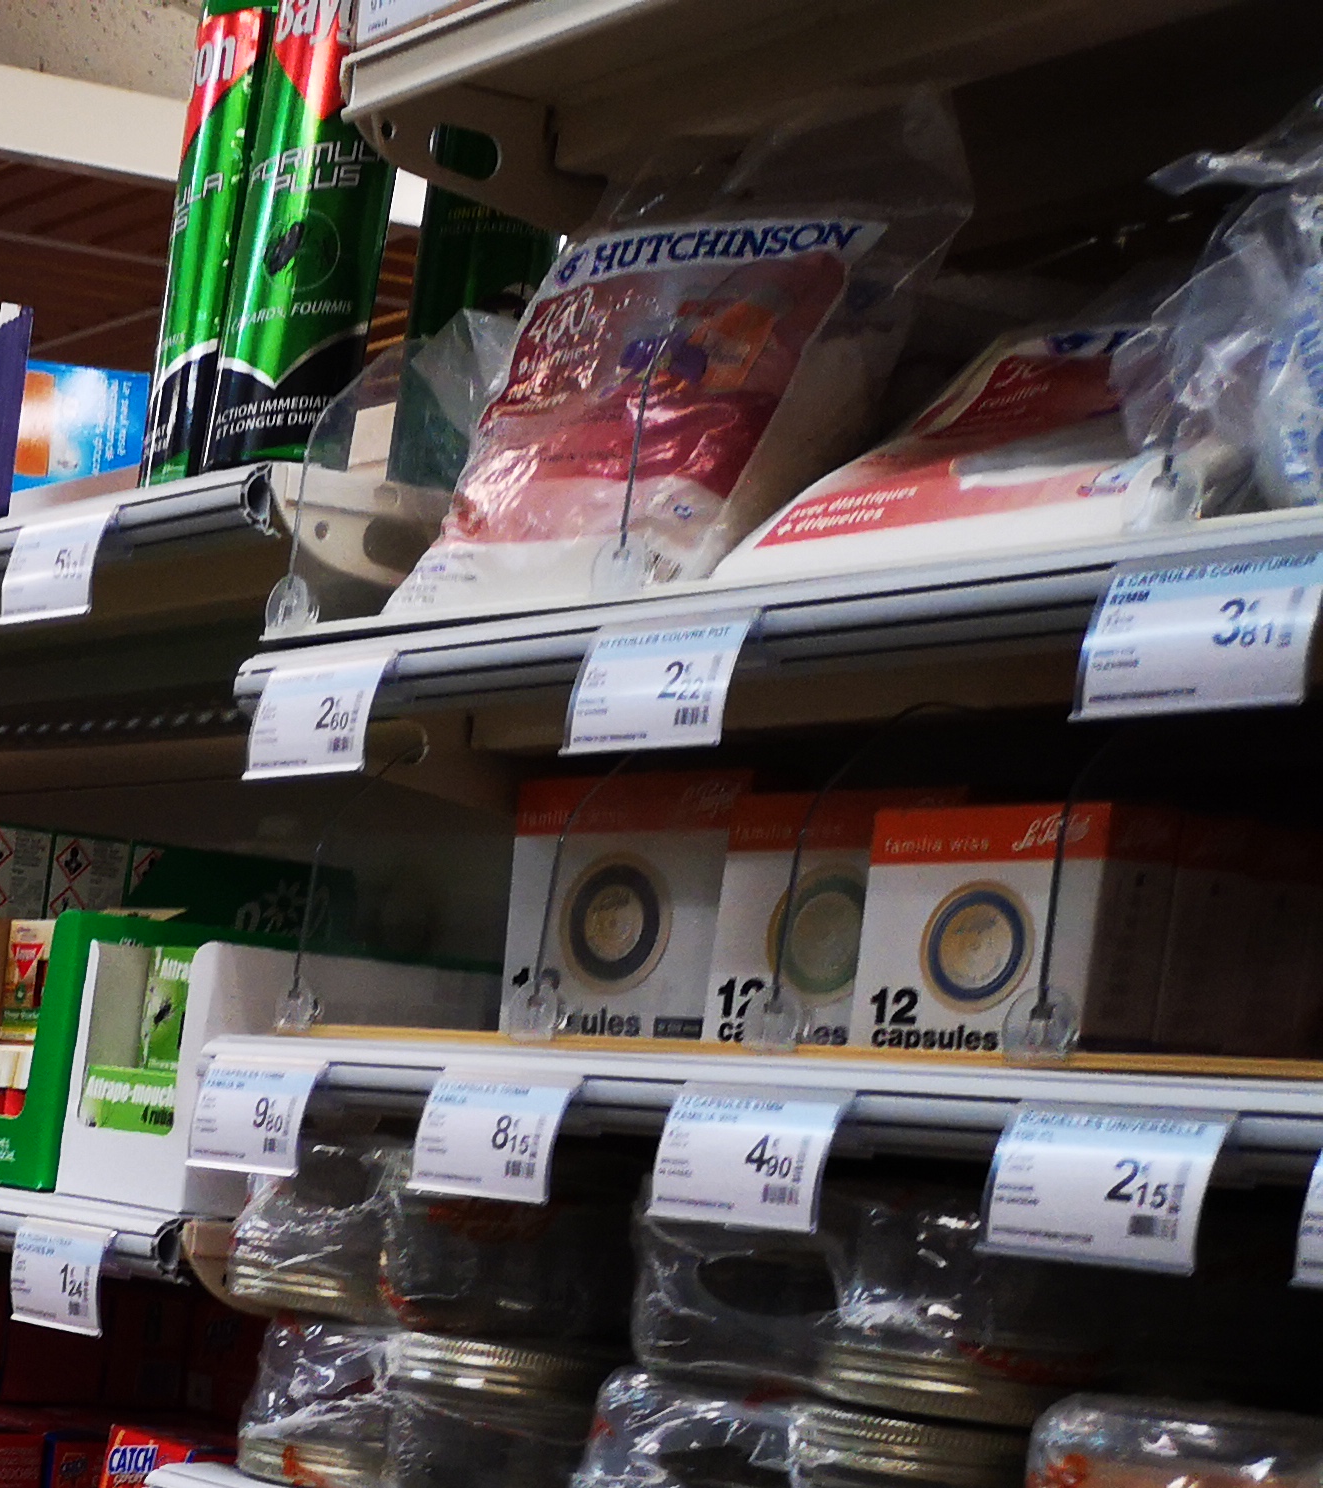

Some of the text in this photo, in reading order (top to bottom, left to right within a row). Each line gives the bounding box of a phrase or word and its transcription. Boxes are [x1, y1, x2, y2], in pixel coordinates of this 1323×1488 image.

[587, 221, 864, 276] HUTCHINSON
[215, 401, 257, 426] ACTION
[229, 412, 284, 434] LONGUE
[884, 837, 941, 854] familia
[870, 987, 918, 1025] 12
[870, 1025, 999, 1051] capsules
[107, 1445, 155, 1474] CATCH
